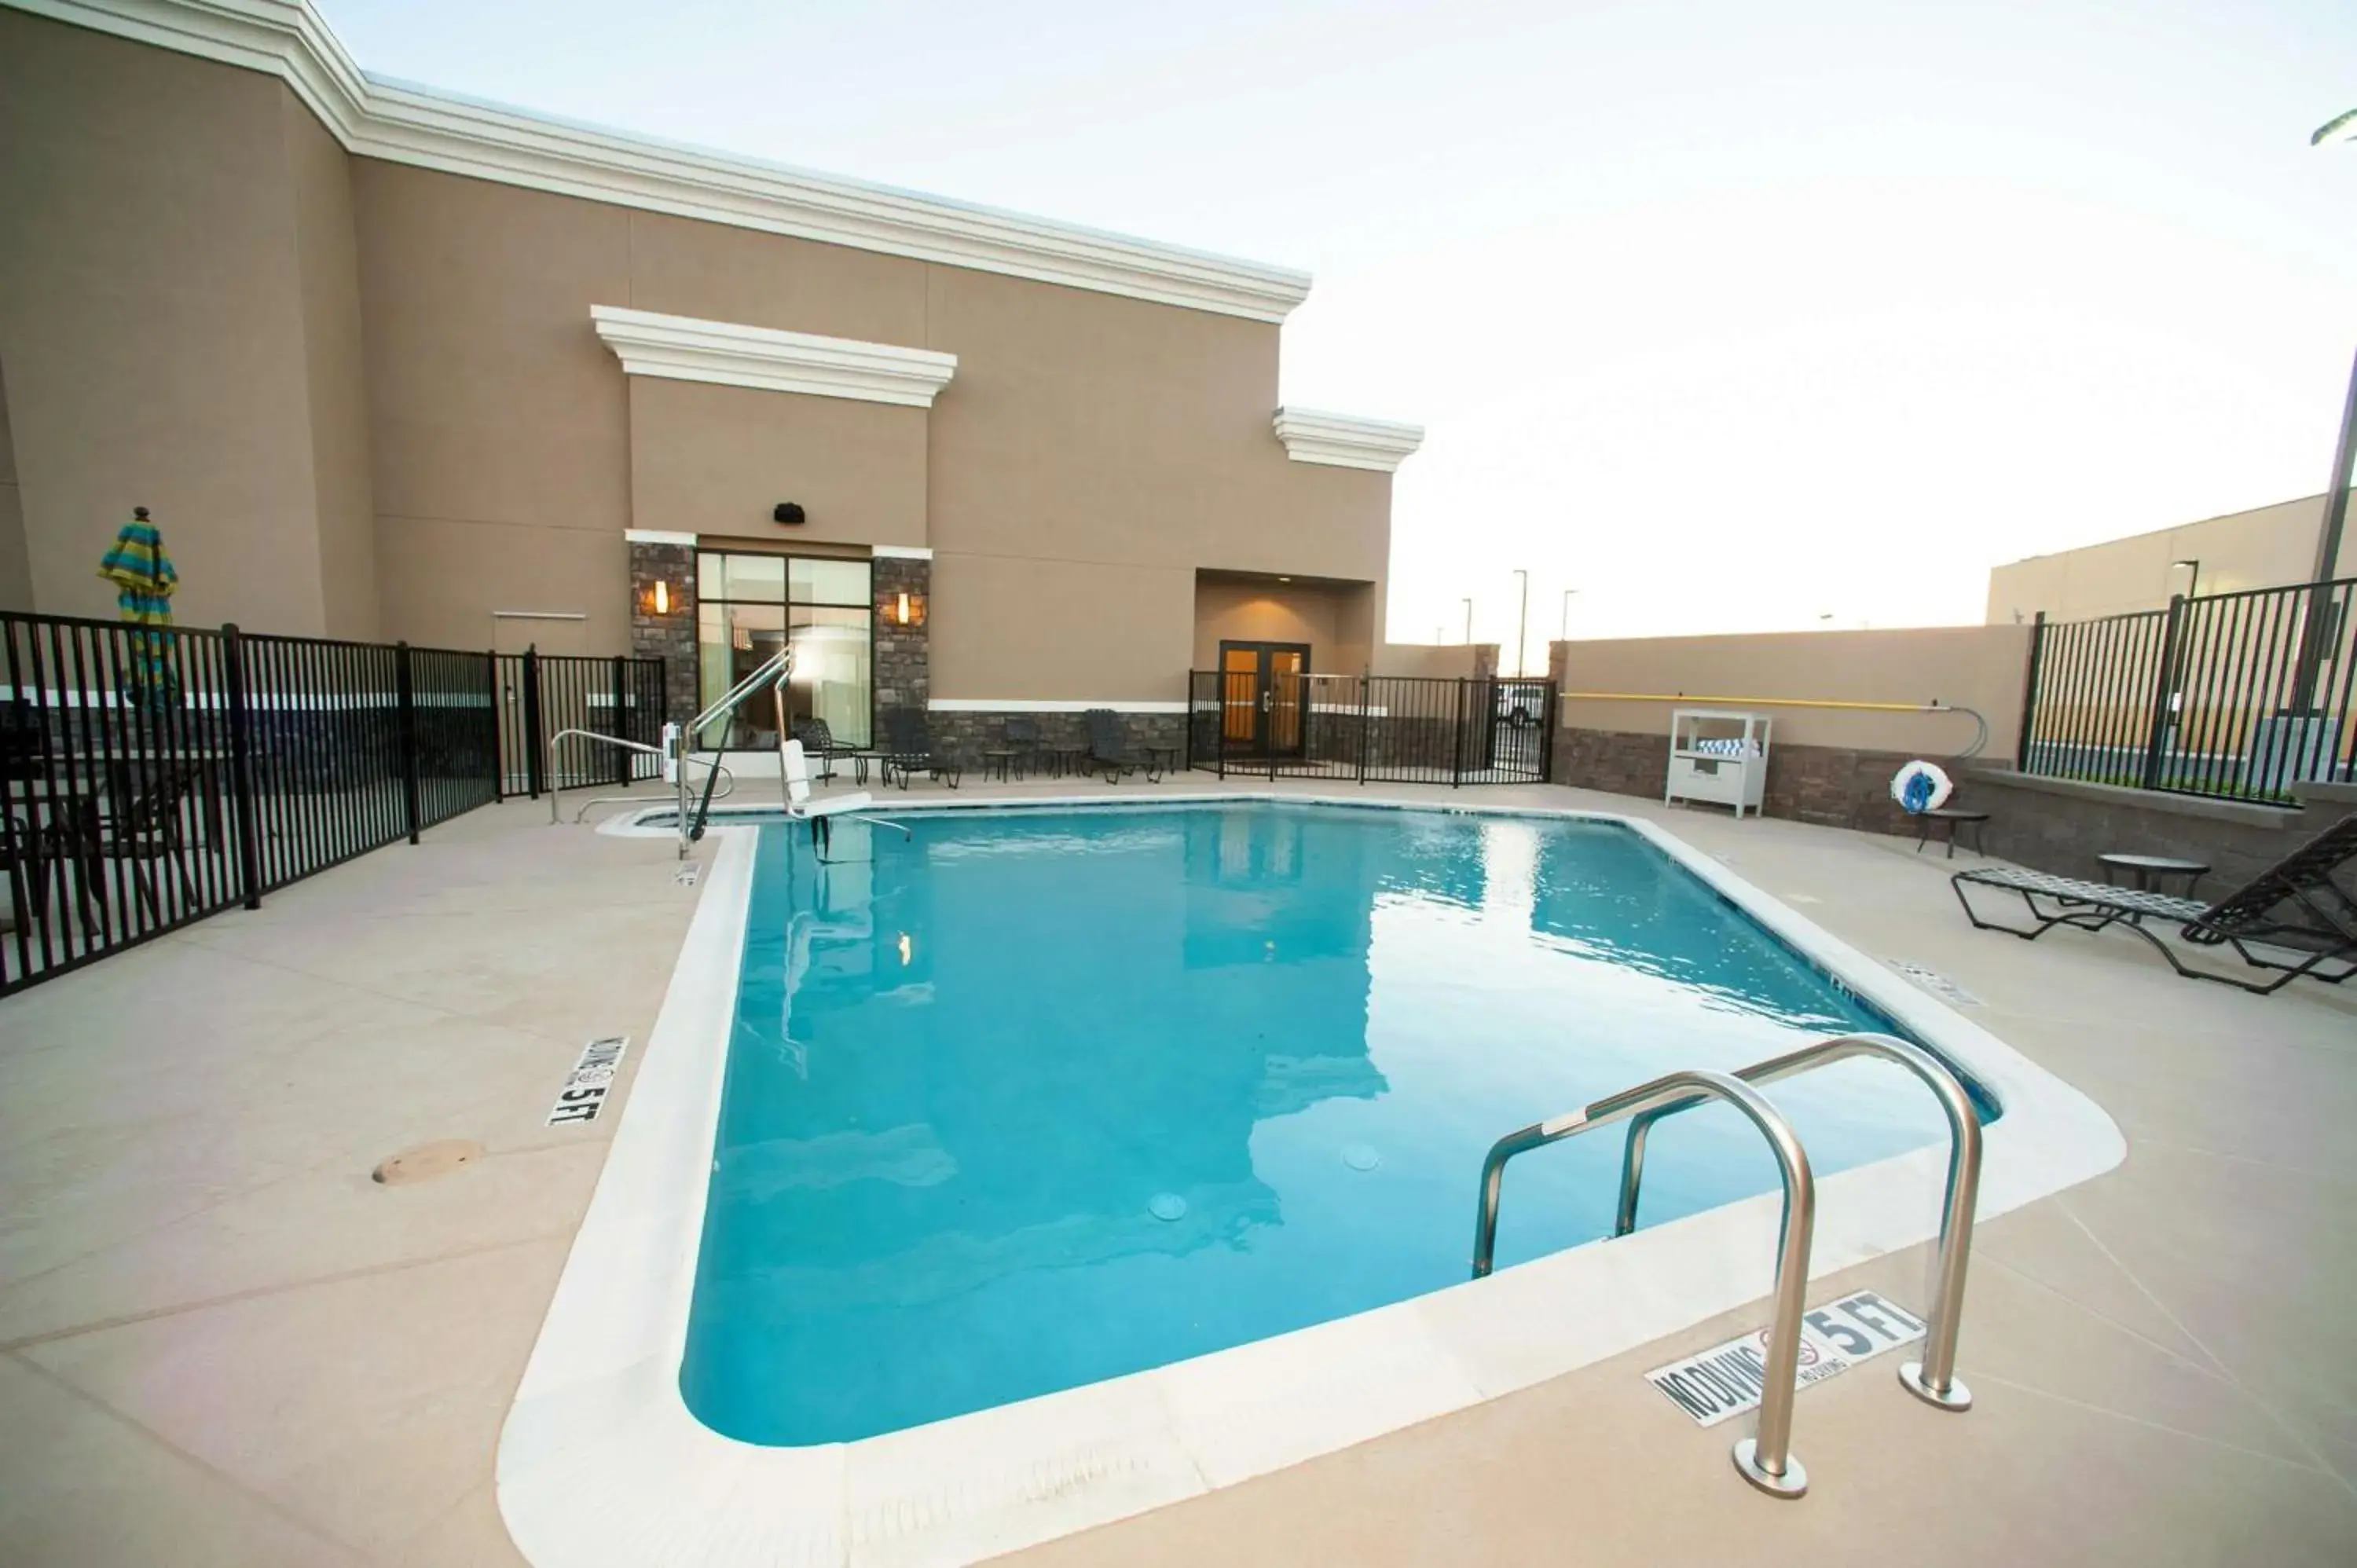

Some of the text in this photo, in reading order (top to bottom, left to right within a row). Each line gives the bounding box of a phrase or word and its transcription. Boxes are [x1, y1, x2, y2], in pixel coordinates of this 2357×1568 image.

[561, 1087, 606, 1101] 5
[550, 1102, 599, 1123] FT
[1803, 1294, 1922, 1355] 5 FT
[1654, 1372, 1721, 1420] NO
